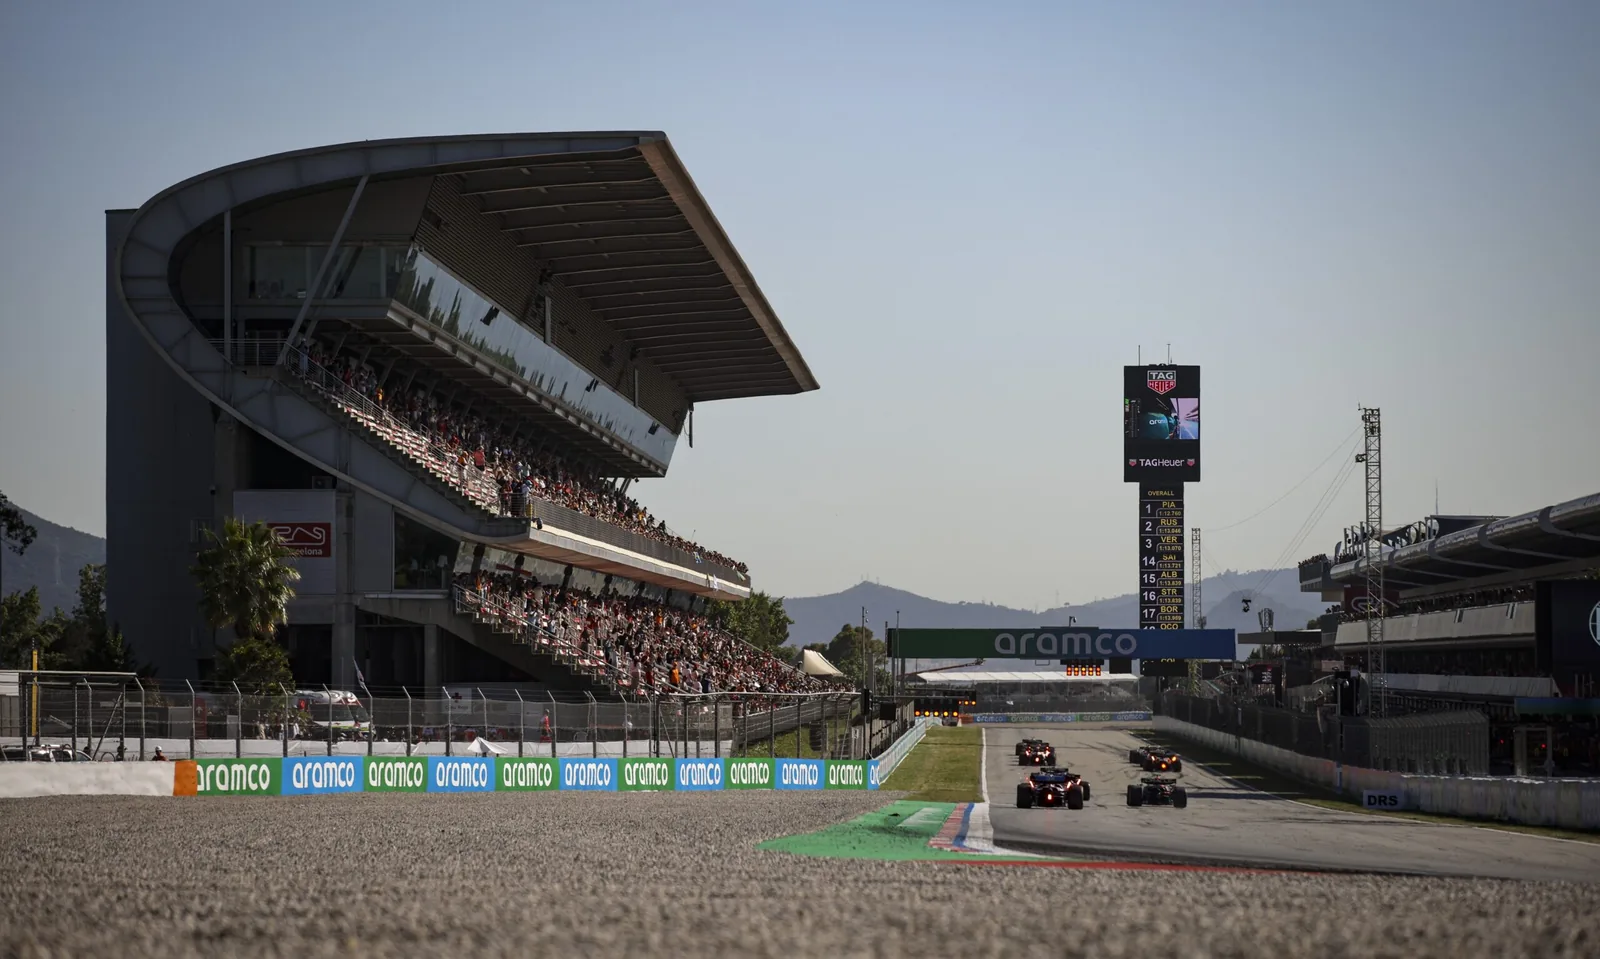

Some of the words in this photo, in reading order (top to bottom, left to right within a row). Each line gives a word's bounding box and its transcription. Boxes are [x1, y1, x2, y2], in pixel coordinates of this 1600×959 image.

[1150, 372, 1174, 380] TAG
[1149, 381, 1174, 393] HEUER
[1145, 504, 1151, 513] 1
[1145, 521, 1152, 531] 2
[1145, 539, 1152, 548] 3
[1142, 556, 1156, 566] 14
[1142, 574, 1156, 583] 15
[1142, 591, 1156, 601] 16
[1142, 608, 1156, 618] 17
[995, 632, 1137, 655] aramco
[292, 762, 355, 789] aramco
[369, 762, 423, 787] aramco
[436, 762, 487, 787] aramco
[503, 763, 553, 787] aramco
[565, 763, 611, 786] aramco
[625, 763, 668, 785] aramco
[680, 763, 721, 785] aramco
[731, 763, 770, 784] aramco
[782, 764, 818, 785] aramco
[829, 764, 863, 785] aramco
[1367, 795, 1398, 806] DRS
